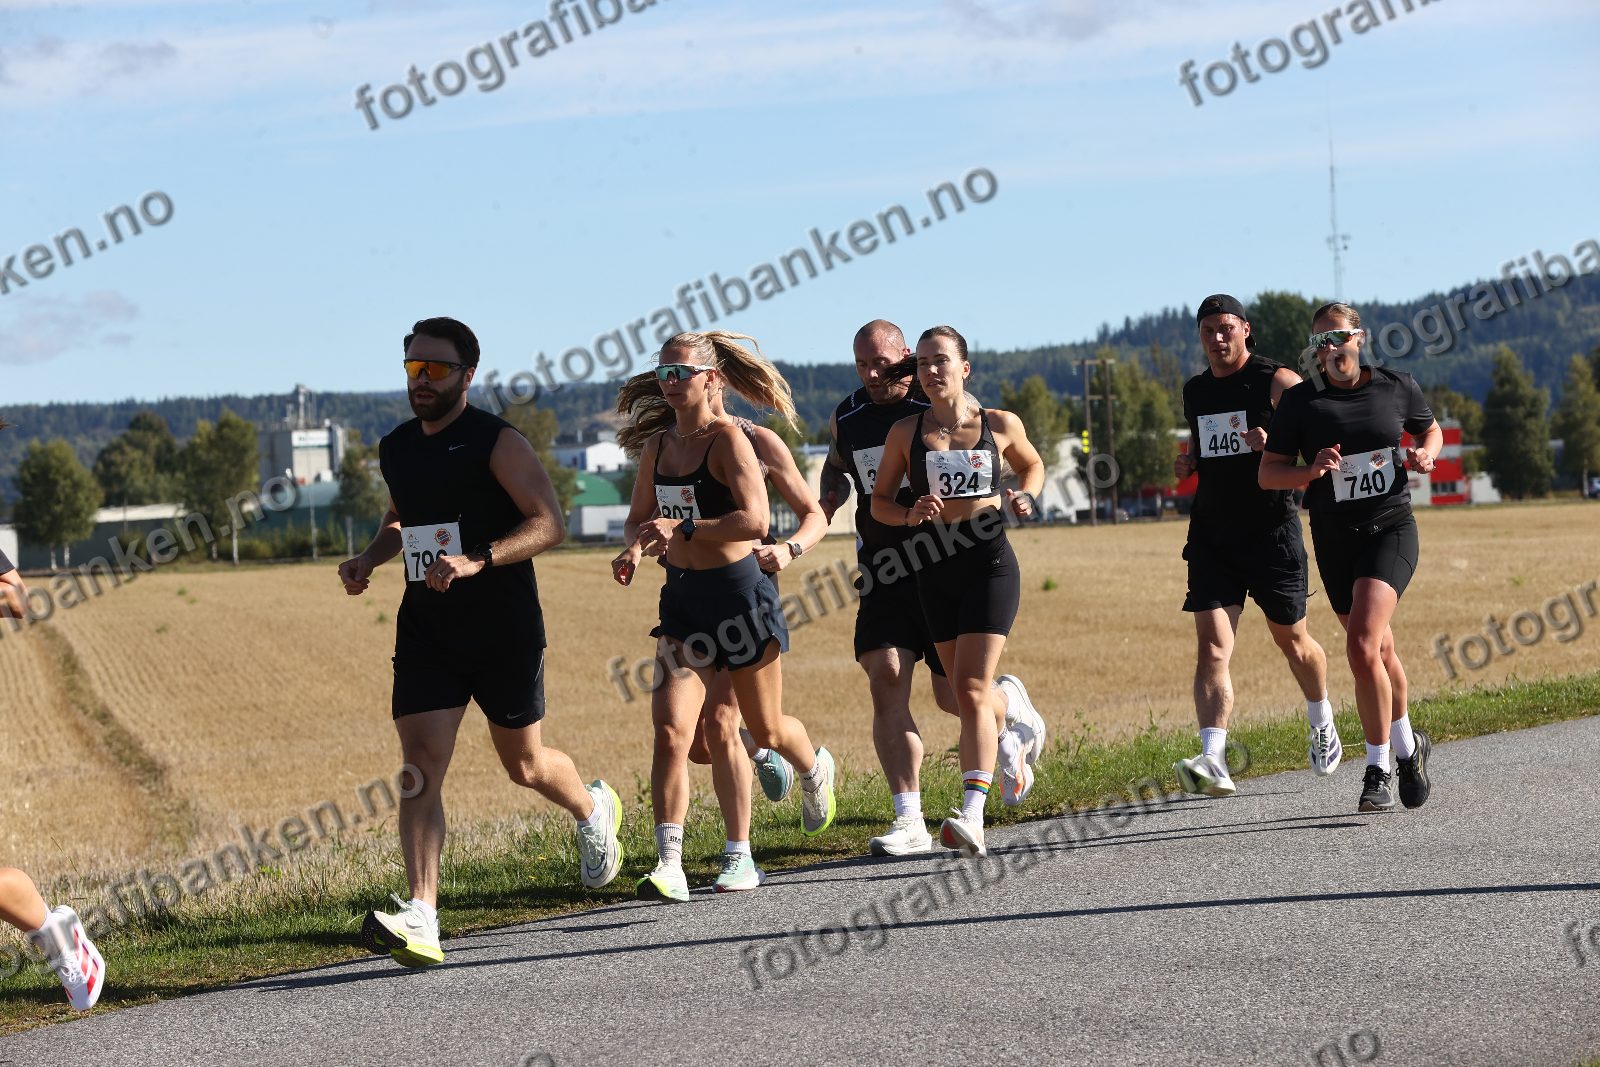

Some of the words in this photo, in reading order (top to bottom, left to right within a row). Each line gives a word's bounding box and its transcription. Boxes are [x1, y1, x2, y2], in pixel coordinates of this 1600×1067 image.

[1209, 431, 1240, 454] 446
[938, 471, 980, 497] 324
[1343, 469, 1386, 498] 740
[411, 549, 448, 578] 79
